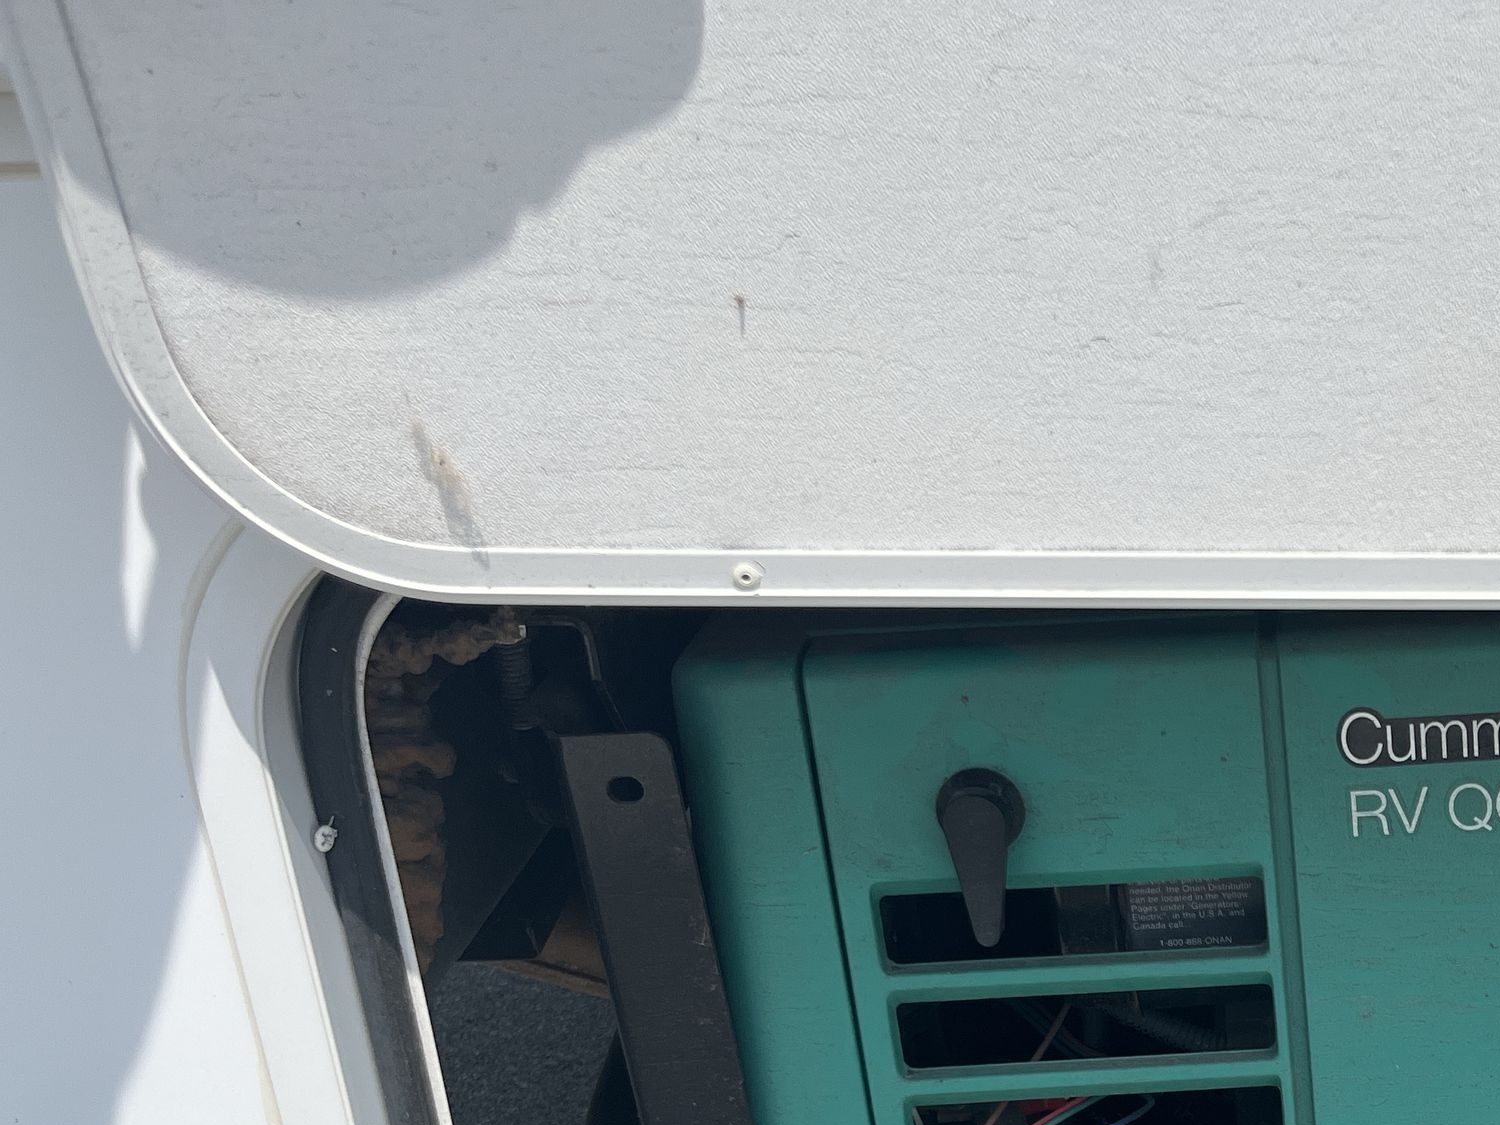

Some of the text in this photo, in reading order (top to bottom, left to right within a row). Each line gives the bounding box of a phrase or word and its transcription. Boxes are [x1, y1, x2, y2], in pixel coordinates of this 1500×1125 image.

[1350, 786, 1429, 838] RV
[1182, 884, 1206, 892] Onan
[1208, 882, 1251, 892] Distributor
[1161, 894, 1192, 902] located
[1205, 892, 1218, 900] the
[1221, 892, 1248, 900] Yellow
[1130, 902, 1185, 914] Pages under
[1182, 910, 1196, 918] the
[1132, 922, 1166, 930] Canada
